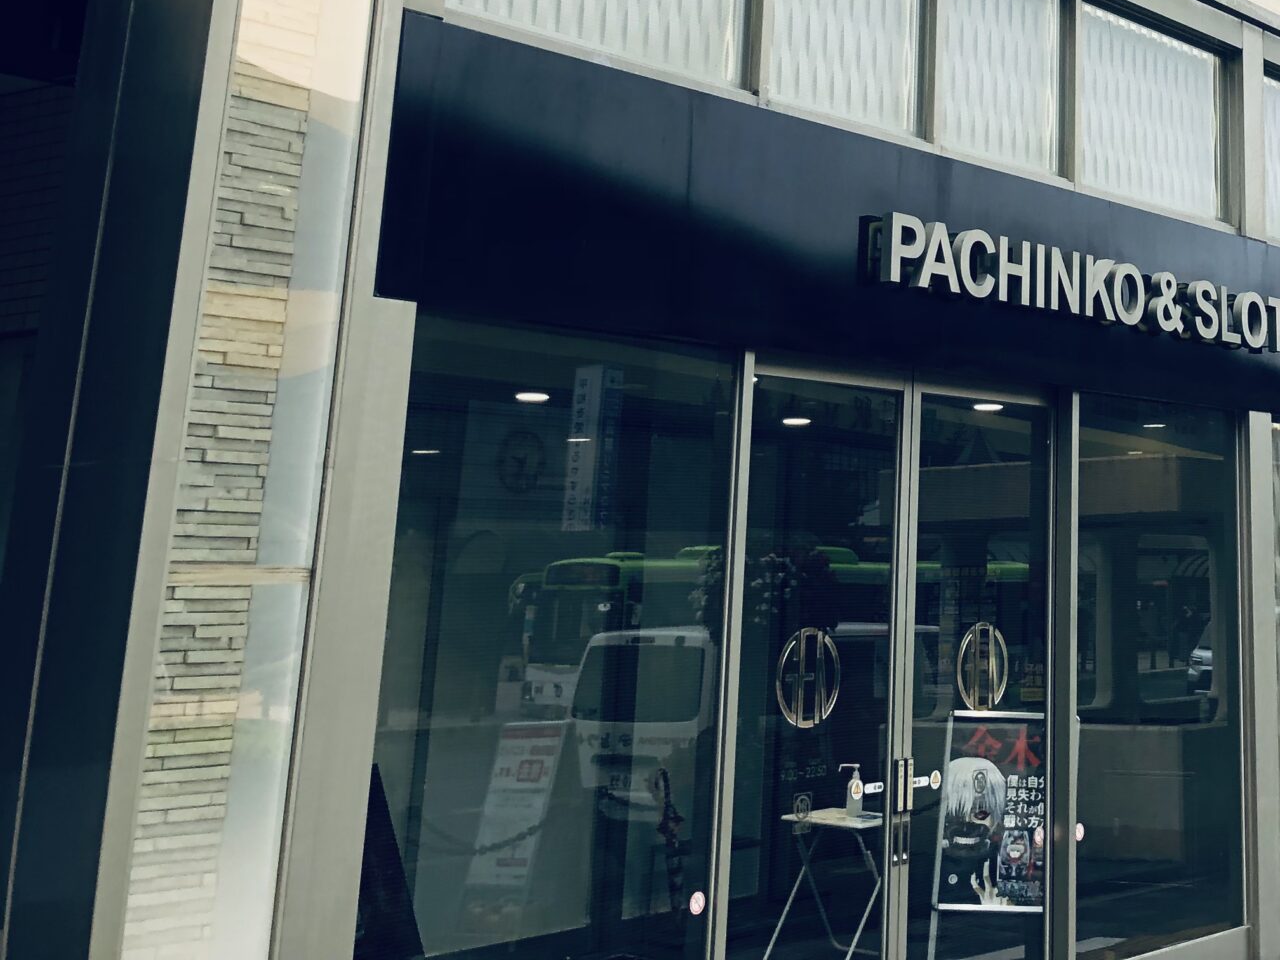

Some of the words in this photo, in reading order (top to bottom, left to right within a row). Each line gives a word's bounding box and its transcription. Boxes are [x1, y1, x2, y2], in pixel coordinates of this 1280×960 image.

[885, 211, 1146, 327] PACHINKO
[1149, 271, 1185, 335] &
[1006, 788, 1045, 801] 見失わ
[1003, 814, 1045, 829] 戦い方
